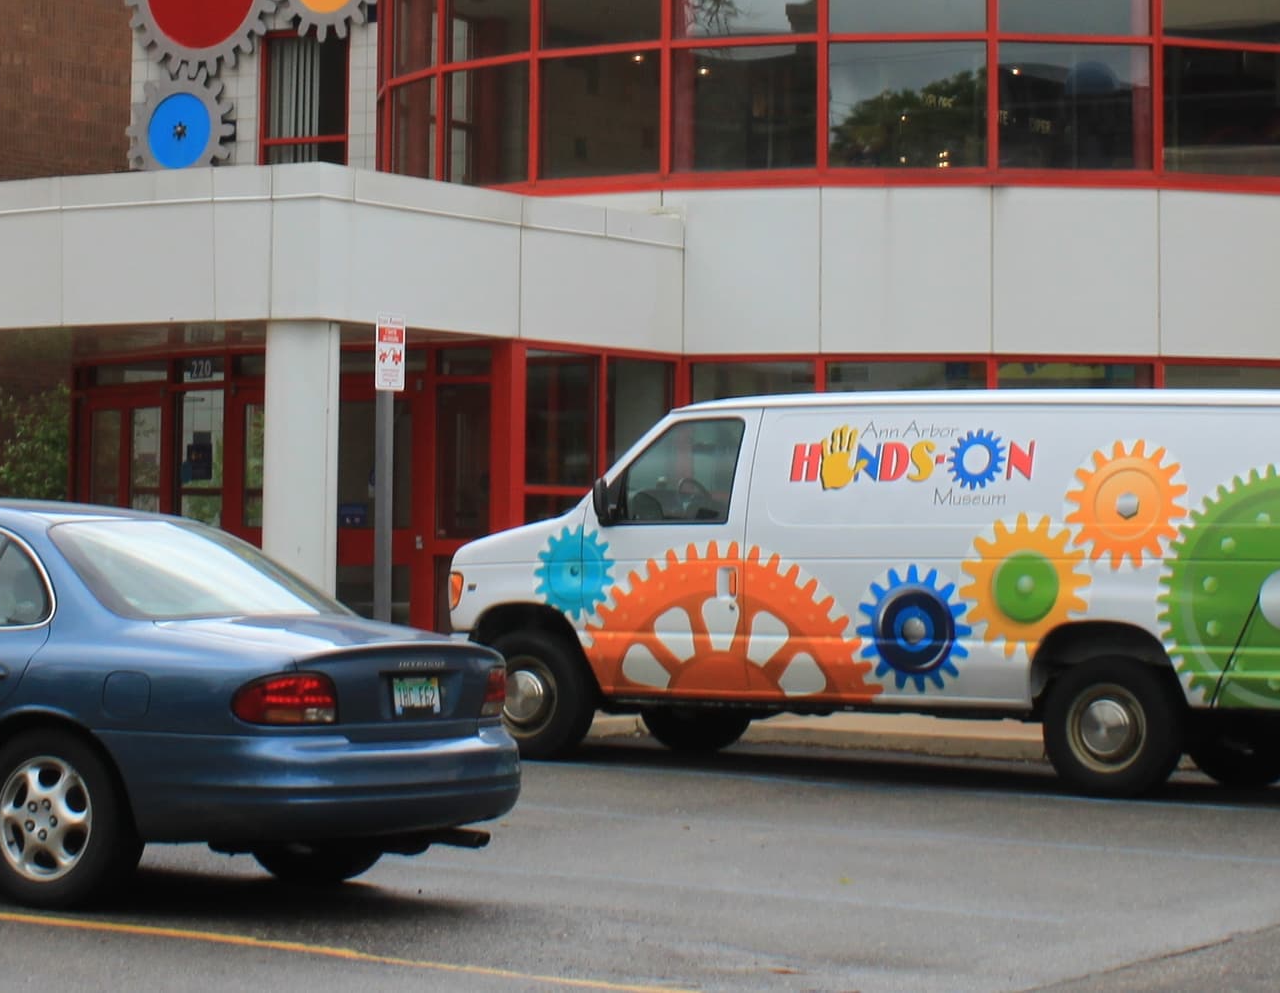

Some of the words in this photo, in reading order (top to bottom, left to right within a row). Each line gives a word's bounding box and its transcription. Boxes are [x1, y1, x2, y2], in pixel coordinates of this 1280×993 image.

[192, 359, 212, 378] 220
[861, 420, 900, 440] Ann
[902, 419, 960, 439] Arbor
[933, 487, 1007, 506] Museum
